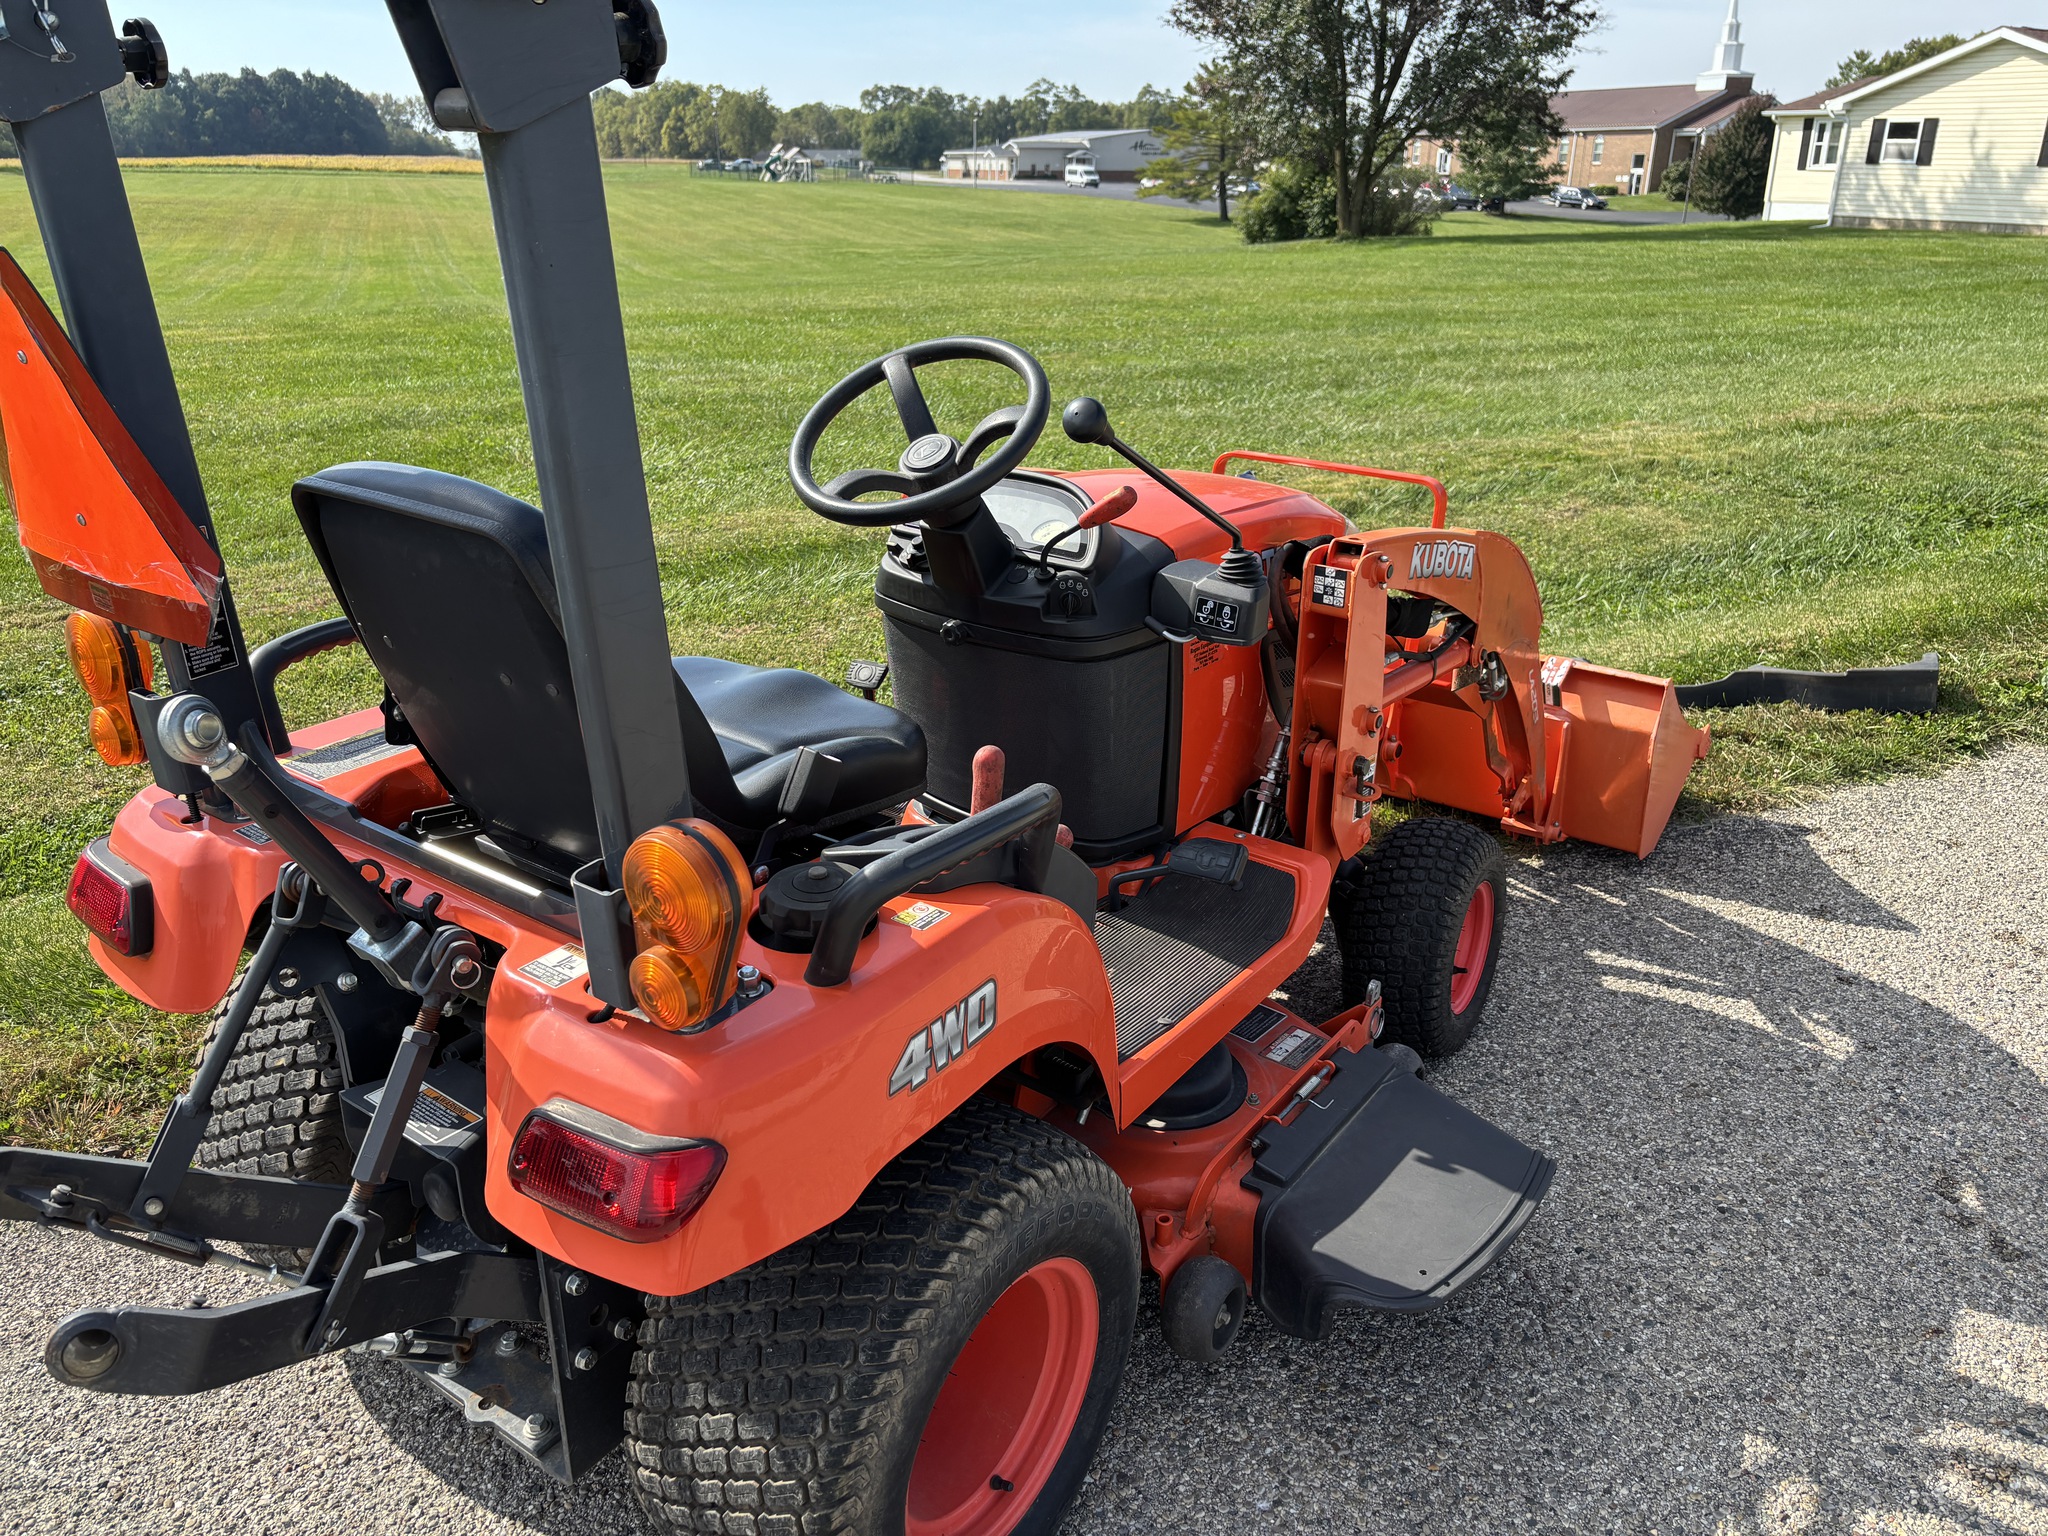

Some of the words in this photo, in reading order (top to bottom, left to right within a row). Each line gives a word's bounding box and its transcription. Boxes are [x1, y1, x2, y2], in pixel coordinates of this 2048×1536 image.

[1408, 540, 1476, 580] KUBOTA
[889, 977, 997, 1097] 4WD
[438, 1094, 469, 1117] WARNING
[962, 1200, 1109, 1323] LITEFOOT
